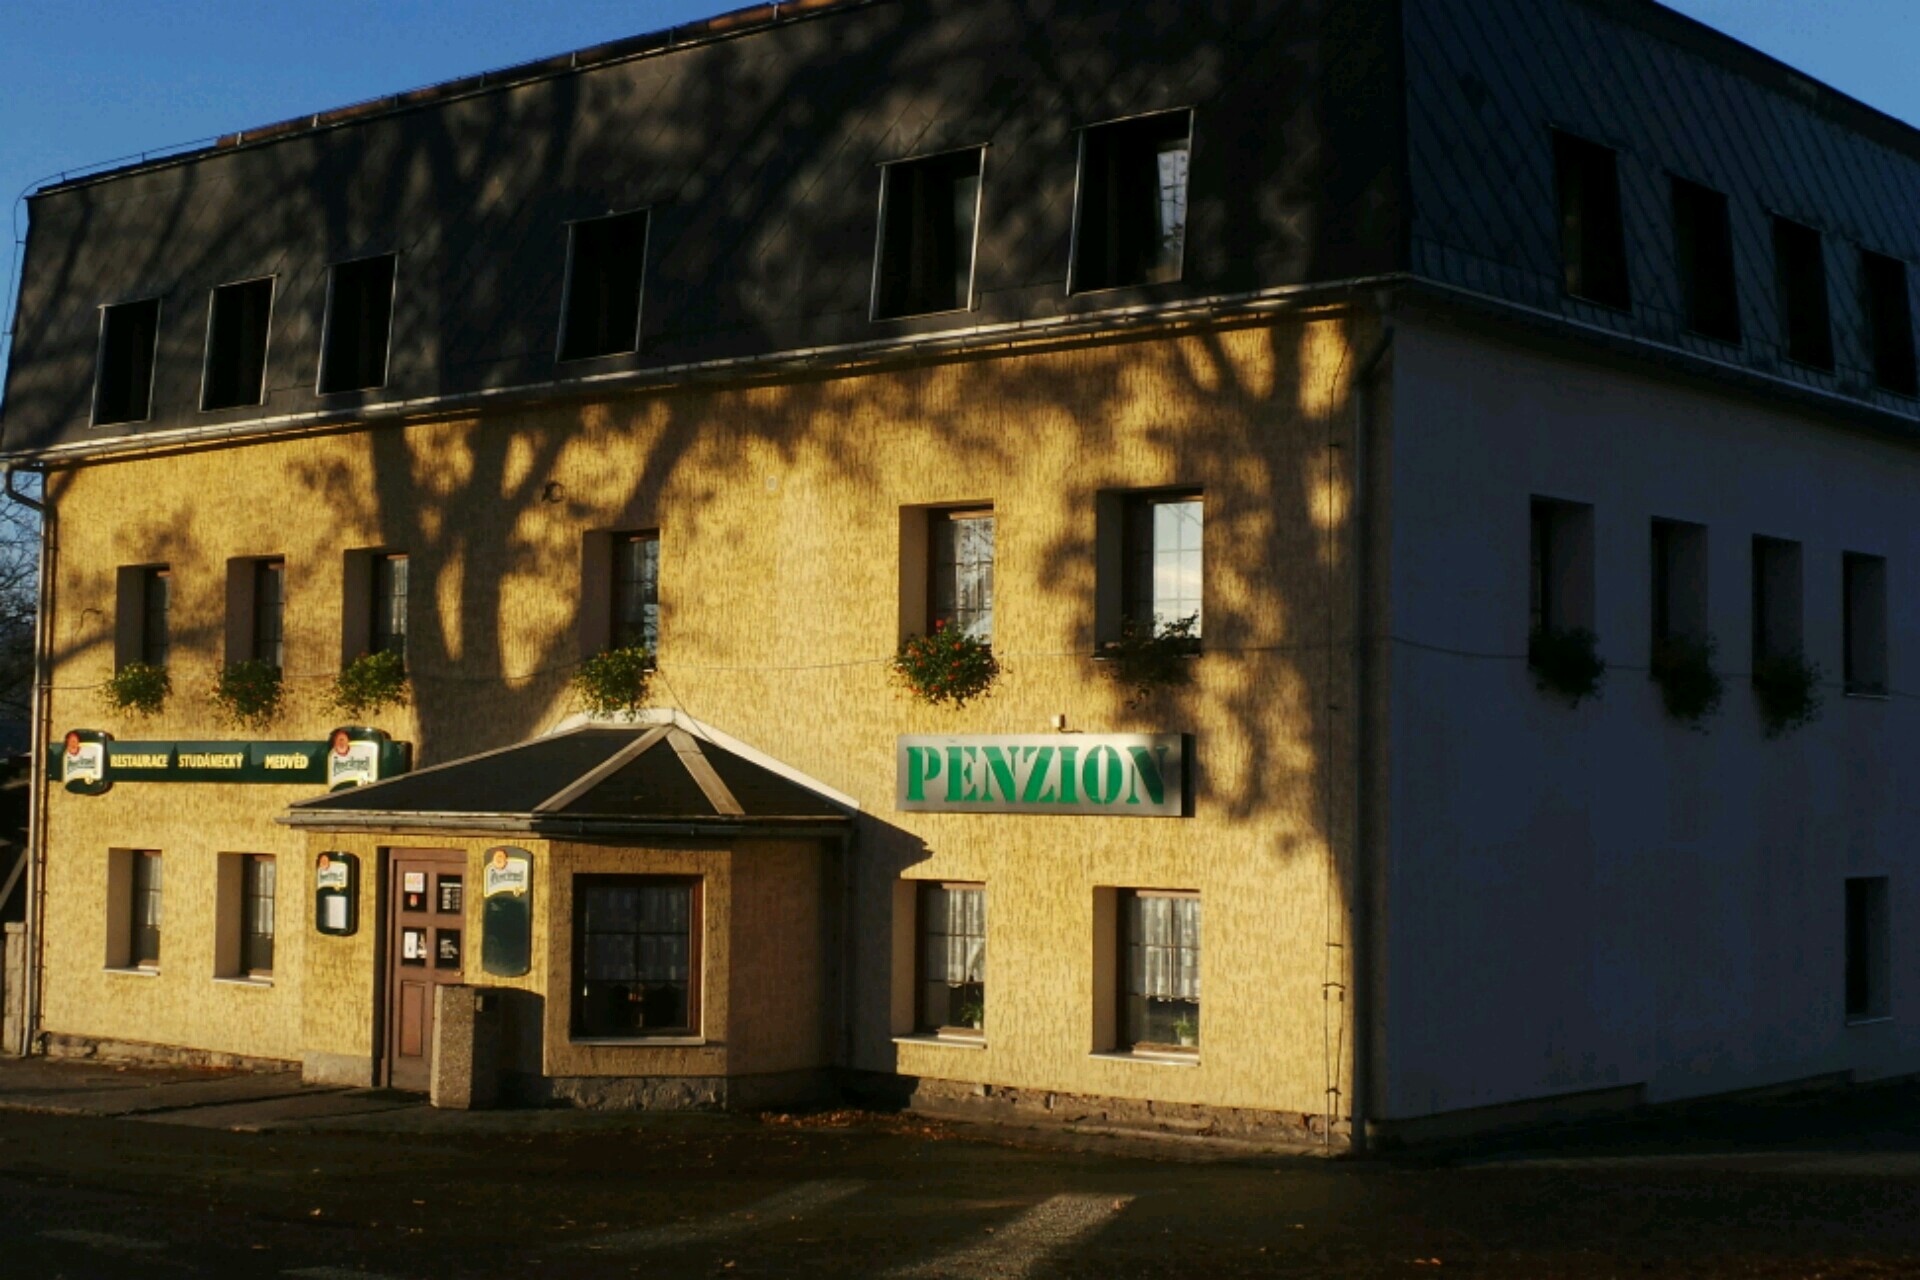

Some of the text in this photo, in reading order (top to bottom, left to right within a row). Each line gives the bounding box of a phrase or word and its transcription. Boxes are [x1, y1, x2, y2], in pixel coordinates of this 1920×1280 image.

[110, 753, 168, 768] RESTAURACE
[264, 752, 309, 769] MEDVĚD
[906, 746, 1169, 805] PENZION
